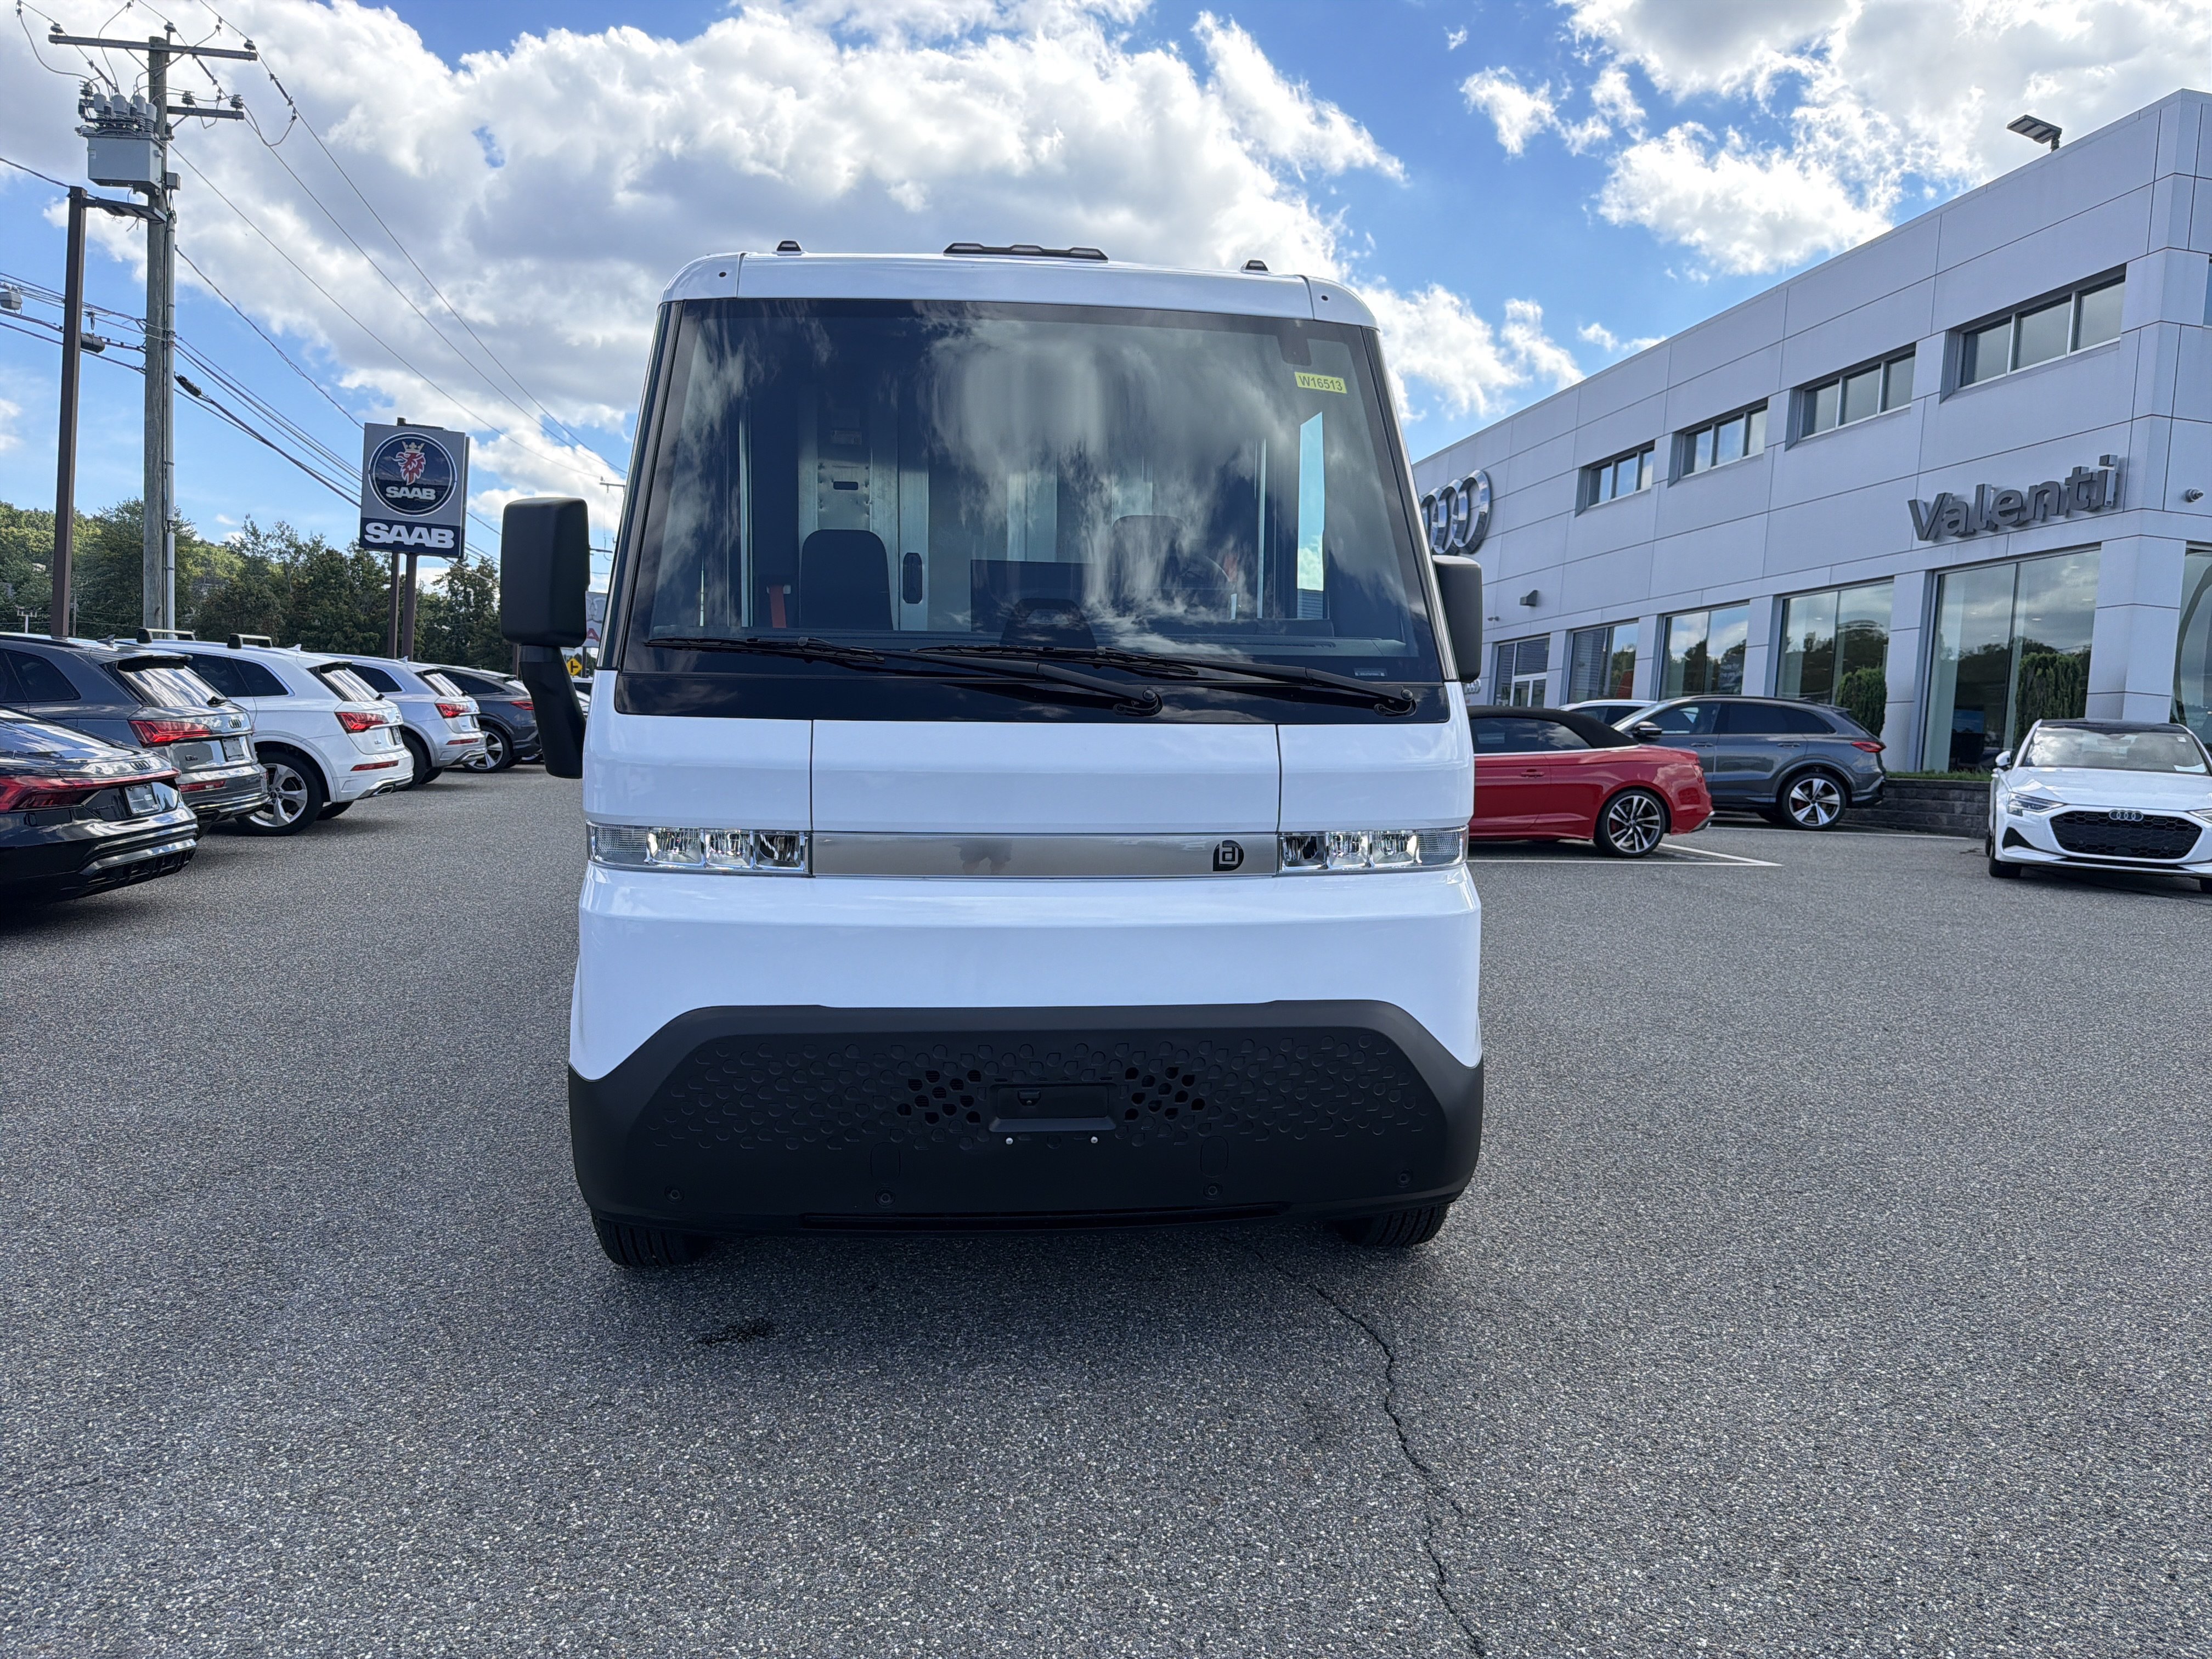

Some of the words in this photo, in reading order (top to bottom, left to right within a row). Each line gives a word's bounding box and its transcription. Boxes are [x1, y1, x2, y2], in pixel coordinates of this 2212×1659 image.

[1298, 375, 1344, 391] W16513
[385, 486, 436, 500] SAAB
[1907, 454, 2118, 541] Valenti
[364, 522, 455, 549] SAAB
